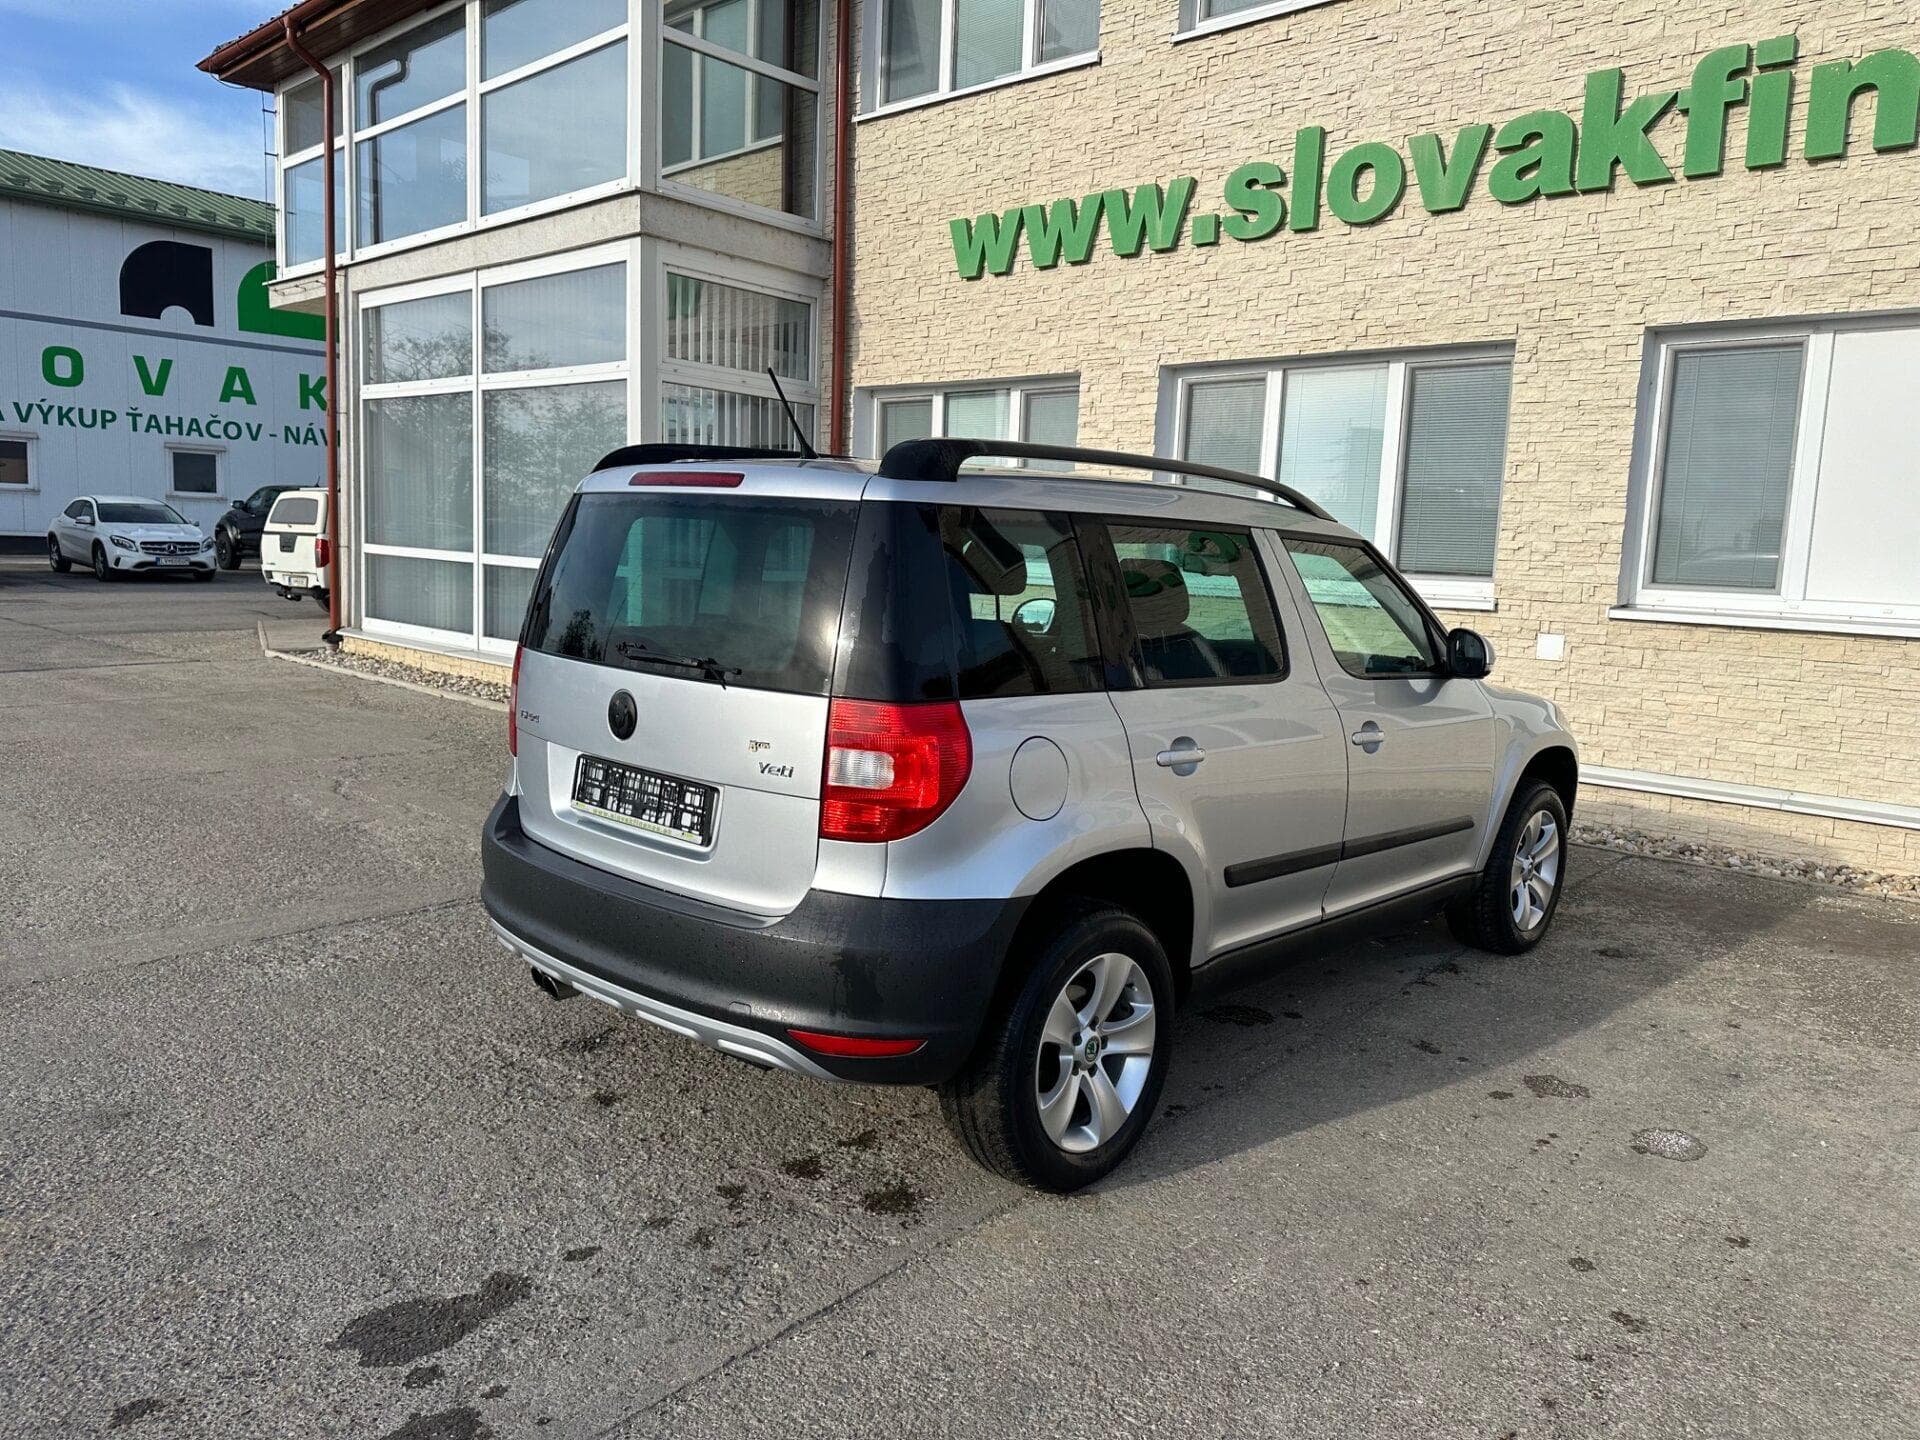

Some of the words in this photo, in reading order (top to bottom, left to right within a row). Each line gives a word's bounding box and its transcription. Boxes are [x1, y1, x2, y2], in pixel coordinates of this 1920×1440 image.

[950, 34, 1920, 280] www.slovakfin
[12, 398, 117, 429] VÝKUP
[126, 407, 263, 442] ŤAHAČOV
[759, 762, 794, 778] Yeti
